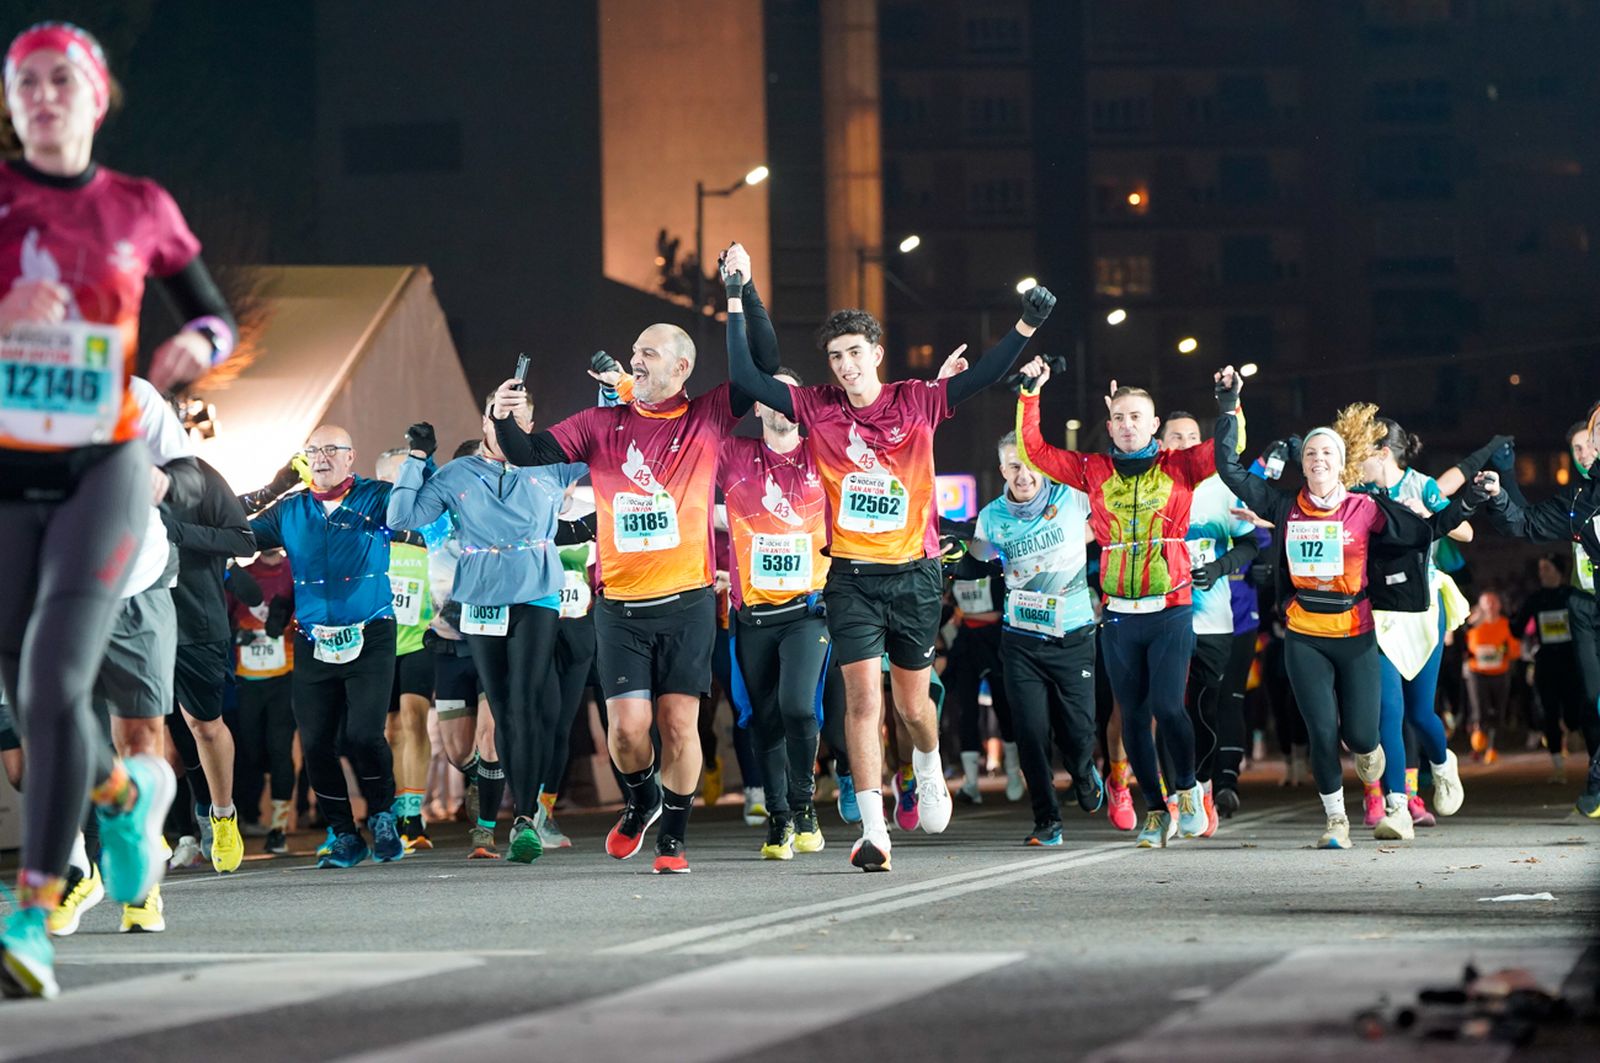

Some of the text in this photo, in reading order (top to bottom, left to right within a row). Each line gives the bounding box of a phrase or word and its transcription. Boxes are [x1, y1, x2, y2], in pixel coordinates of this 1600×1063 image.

[5, 364, 99, 403] 12146
[859, 453, 875, 469] 43
[634, 469, 651, 486] 43
[774, 502, 789, 518] 43
[850, 493, 900, 516] 12562
[622, 512, 668, 532] 13185
[1300, 541, 1323, 557] 172
[763, 554, 801, 571] 5387
[469, 605, 501, 620] 10037
[1019, 607, 1050, 622] 10850
